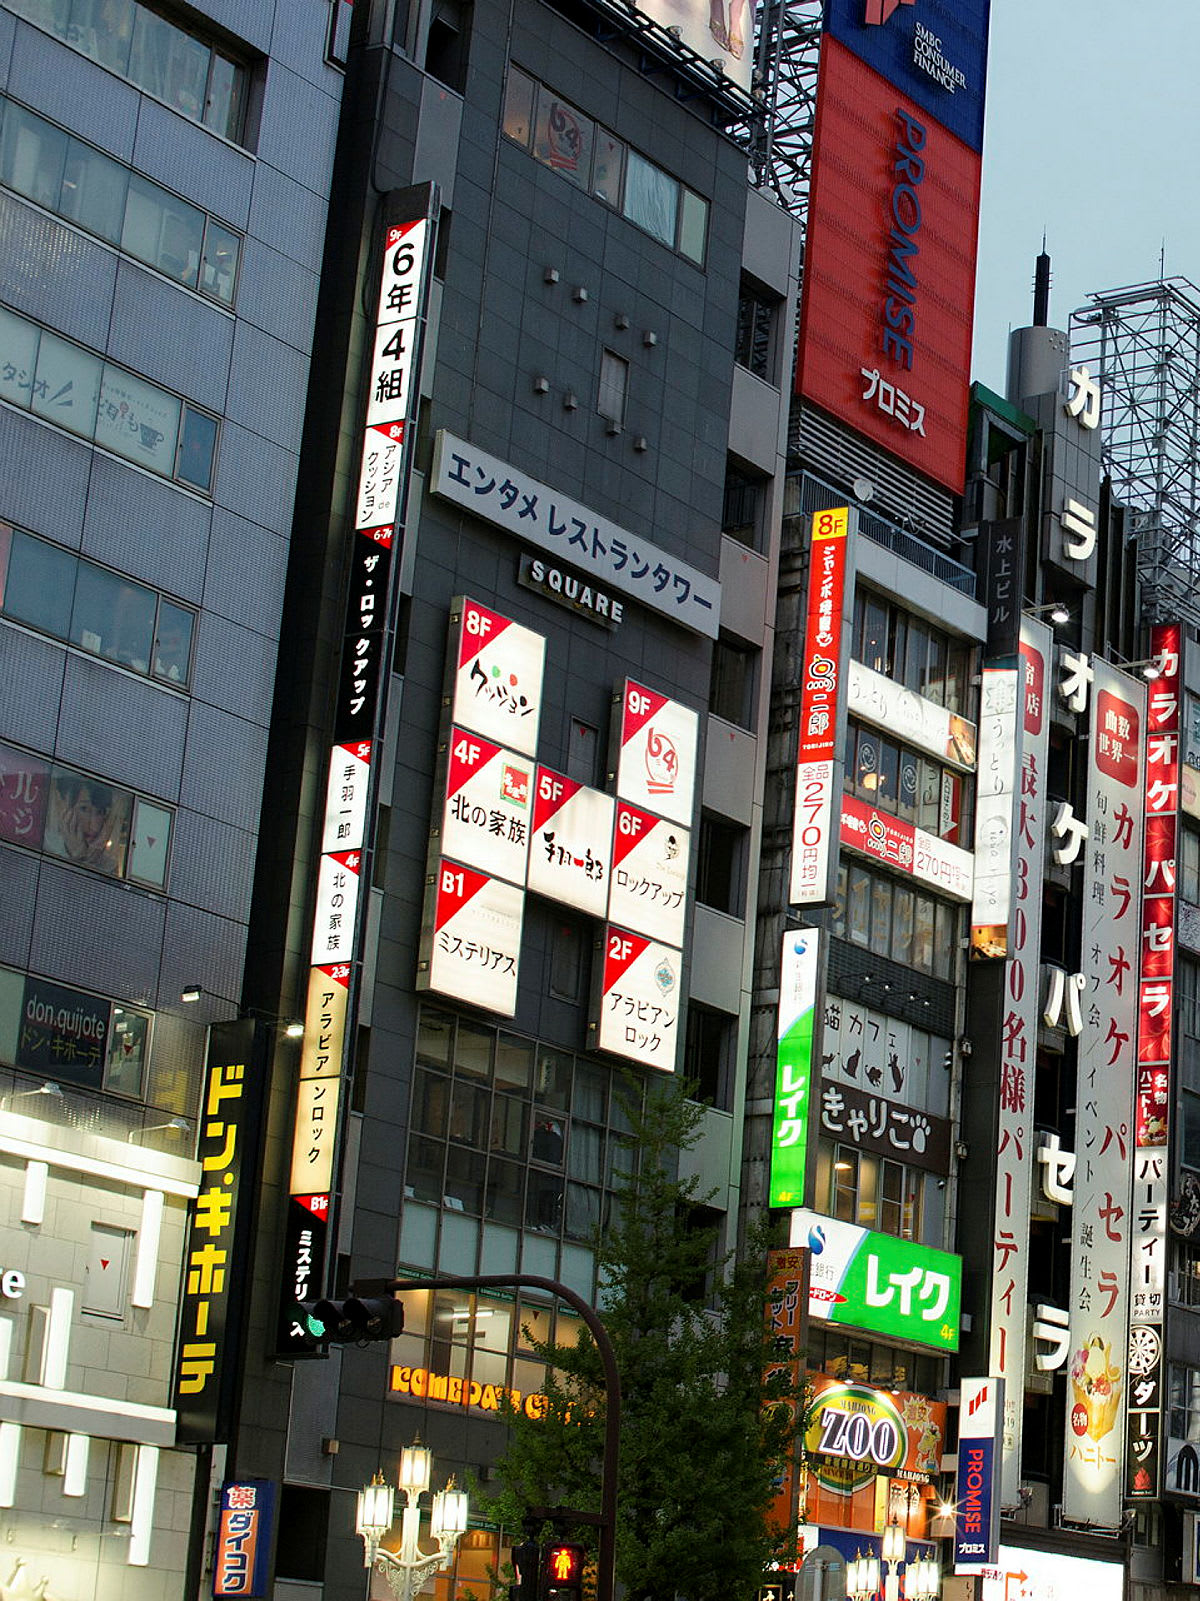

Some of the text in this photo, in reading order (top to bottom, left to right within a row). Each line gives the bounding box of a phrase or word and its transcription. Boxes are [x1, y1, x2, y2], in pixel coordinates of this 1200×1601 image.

[915, 21, 942, 53] SMBC
[914, 49, 955, 94] FINANCE
[915, 36, 967, 89] CONSUMER
[389, 228, 403, 242] 9F
[882, 107, 926, 372] PROMISE
[375, 242, 415, 402] 6年4組
[861, 367, 926, 438] プロミス
[389, 425, 403, 438] 8F
[361, 452, 379, 522] クッション
[818, 514, 843, 535] 8F
[531, 560, 624, 623] SQUARE
[992, 536, 1012, 624] 水上ビル
[466, 610, 492, 637] 8F
[470, 658, 536, 718] クッション
[628, 690, 651, 716] 9F
[1105, 709, 1130, 740] 曲数
[357, 743, 371, 757] 5F
[454, 740, 480, 765] 4F
[1099, 733, 1136, 762] 世界一
[540, 775, 563, 801] 5F
[802, 765, 830, 783] 全品
[336, 765, 357, 840] 手羽一郎
[450, 793, 525, 847] 北の家族
[619, 811, 642, 836] 6F
[345, 852, 361, 867] 4F
[543, 831, 603, 880] 手羽一郎
[443, 873, 465, 897] B1
[616, 869, 685, 910] ロックアップ
[326, 871, 347, 951] 北の家族
[438, 931, 516, 978] ミステリアス
[609, 936, 633, 960] 2F
[27, 993, 105, 1039] don.quijote
[610, 991, 676, 1028] アラビアン
[21, 1025, 101, 1068] ドン・キホーテ
[625, 1025, 662, 1053] ロック
[307, 992, 334, 1164] アラビアンロック
[1139, 1070, 1152, 1119] ハニトー
[1154, 1073, 1168, 1105] 名物
[777, 1065, 806, 1147] レイク
[821, 1087, 910, 1150] きゃりこ
[310, 1197, 328, 1211] B1F
[779, 1191, 793, 1202] 4F
[180, 1067, 245, 1393] ドン・キホーテ
[1138, 1158, 1163, 1284] パーティー
[290, 1230, 312, 1336] ミステリス
[786, 1279, 800, 1326] フリー
[865, 1254, 950, 1321] レイク
[1134, 1292, 1161, 1306] 貸切
[941, 1324, 954, 1341] 4F
[1133, 1308, 1161, 1317] PARTY
[819, 1408, 898, 1465] ZOO
[1073, 1411, 1087, 1426] 名物
[1070, 1445, 1116, 1471] ハニトー
[226, 1486, 256, 1507] 薬
[964, 1449, 984, 1533] PROMISE
[223, 1514, 254, 1593] ダイコク
[958, 1542, 985, 1554] プロミス
